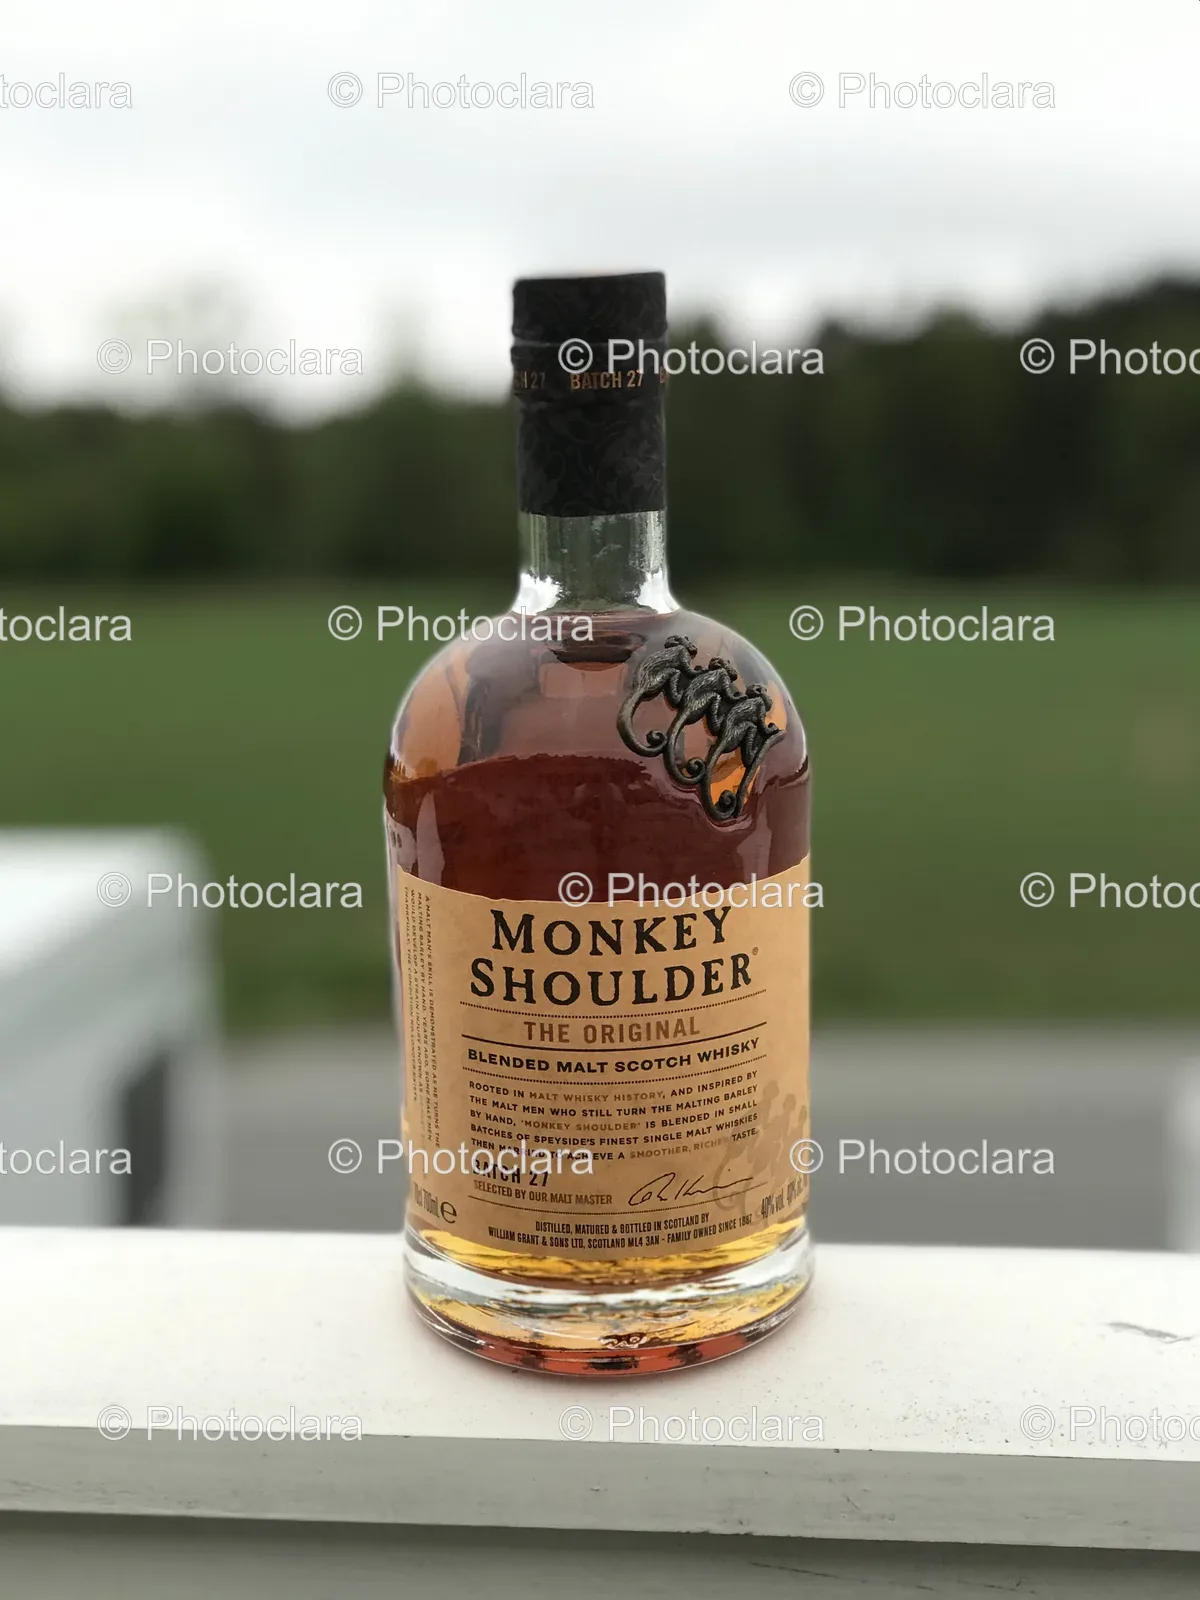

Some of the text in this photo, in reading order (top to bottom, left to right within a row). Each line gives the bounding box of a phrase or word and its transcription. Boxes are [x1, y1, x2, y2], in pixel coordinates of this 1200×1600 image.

[570, 369, 643, 390] BATCH 27
[490, 906, 731, 956] MONKEY
[524, 1016, 700, 1045] THE ORIGINAL
[468, 1037, 760, 1073] BLENDED MALT SCOTCH WHISKY
[469, 1070, 758, 1102] ROOTED IN MALT WHISKY HISTORY, AND INSPIRED BY
[470, 1084, 758, 1117] THE MALT MEN WHO STILL TURN THE MALTING BARLEY
[470, 1109, 481, 1119] BY
[485, 1113, 516, 1127] HAND,
[645, 1121, 656, 1129] IS
[661, 1112, 710, 1128] BLENDED
[714, 1108, 725, 1118] IN
[728, 1099, 757, 1114] SMALL
[471, 1113, 758, 1146] BATCHES OF SPEYSIDE'S FINEST SINGLE MALT WHISKIES
[471, 1138, 495, 1150] THEN
[499, 1144, 546, 1158] MARID
[567, 1152, 614, 1160] ACHEVE
[618, 1152, 625, 1160] A
[629, 1145, 692, 1159] SMOOTHER,
[731, 1127, 759, 1142] TASTE.
[473, 1180, 613, 1205] SELECTED BY OUR MALT MASTER
[488, 1226, 515, 1242] WILLIAM
[517, 1232, 539, 1246] GRANT
[541, 1236, 548, 1246] &
[549, 1237, 569, 1248] SONS
[587, 1238, 625, 1249] SCOTLAND
[627, 1237, 643, 1248] ML4
[645, 1235, 660, 1246] 3AN
[667, 1231, 692, 1243] FAMILY
[693, 1226, 717, 1239] OWNED
[718, 1218, 736, 1232] SINCE
[535, 1212, 710, 1235] DISTILLED, MATURED & BOTTLED IN SCOTLAND BY
